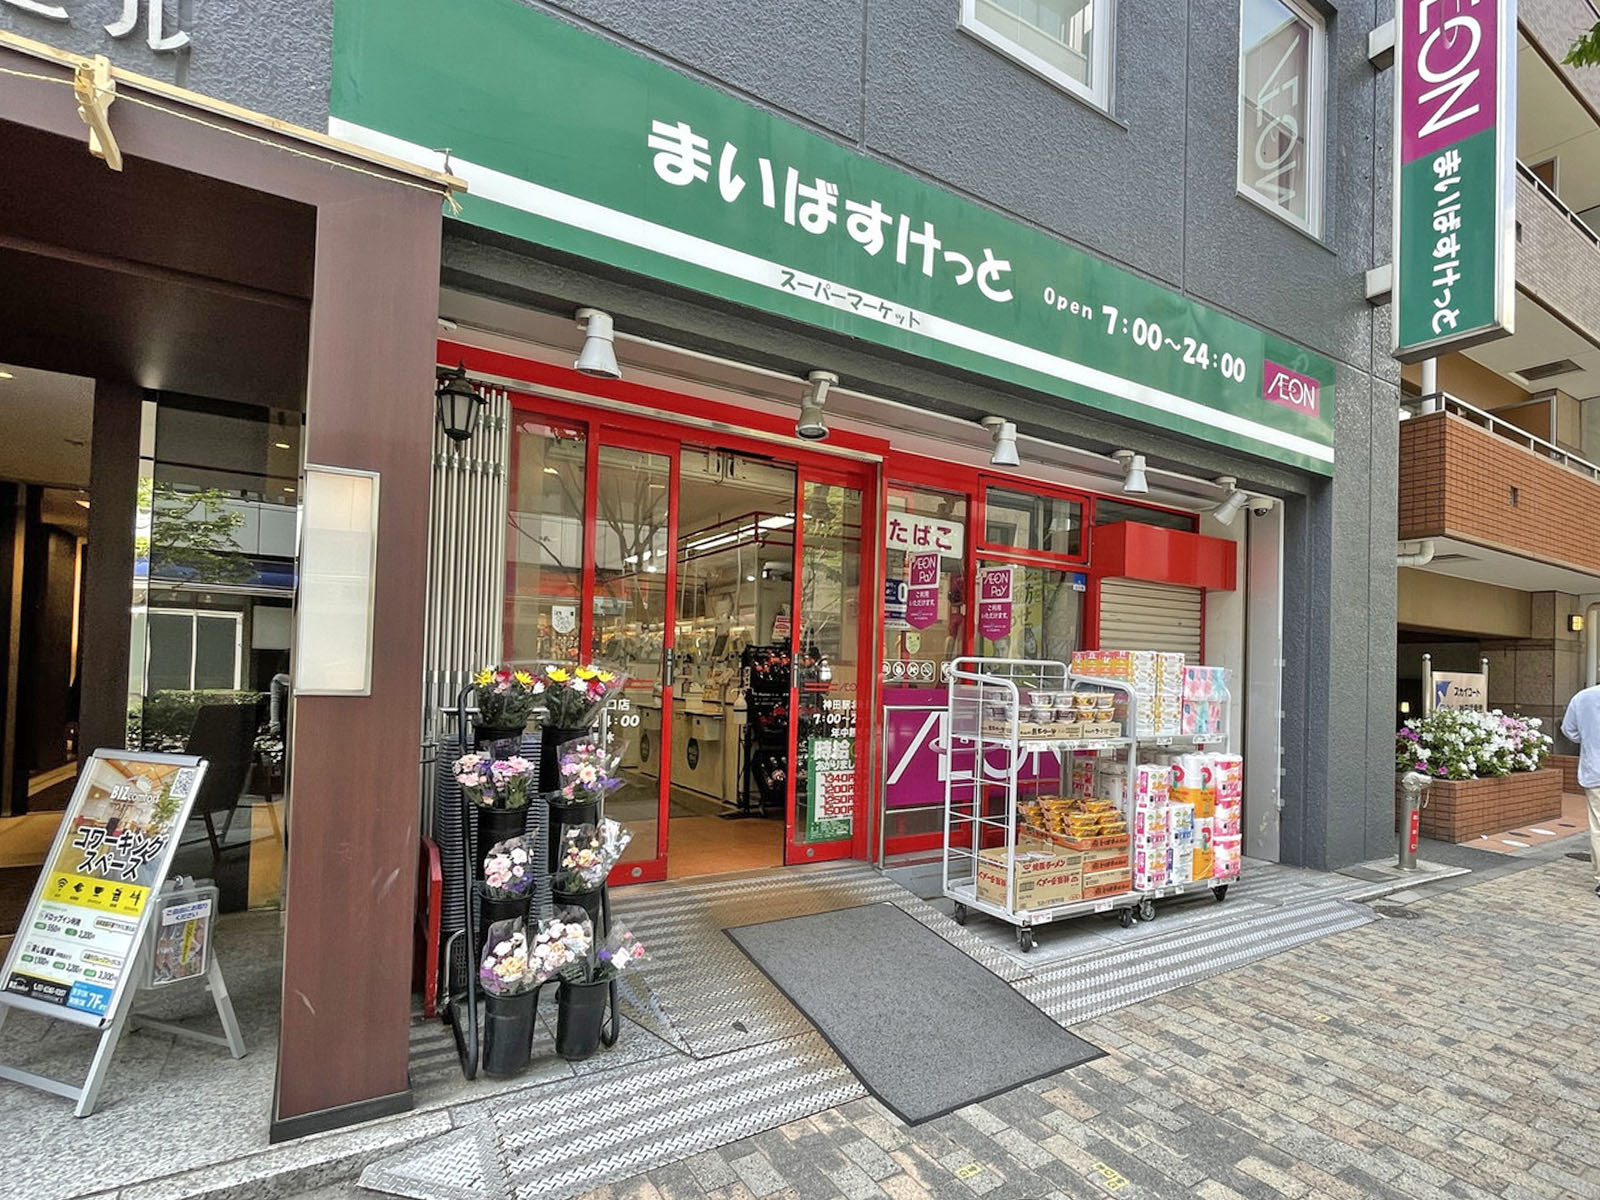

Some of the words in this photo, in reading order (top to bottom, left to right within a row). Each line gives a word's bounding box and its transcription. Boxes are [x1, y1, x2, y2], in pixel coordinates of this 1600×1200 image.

[647, 119, 1014, 303] まいばすけっと
[1431, 149, 1462, 335] まいばすけっと
[780, 270, 921, 331] スーパーマーケット
[1043, 287, 1093, 320] Open
[889, 519, 952, 550] たばこ
[74, 827, 169, 861] コワーキング
[78, 850, 143, 881] スペース
